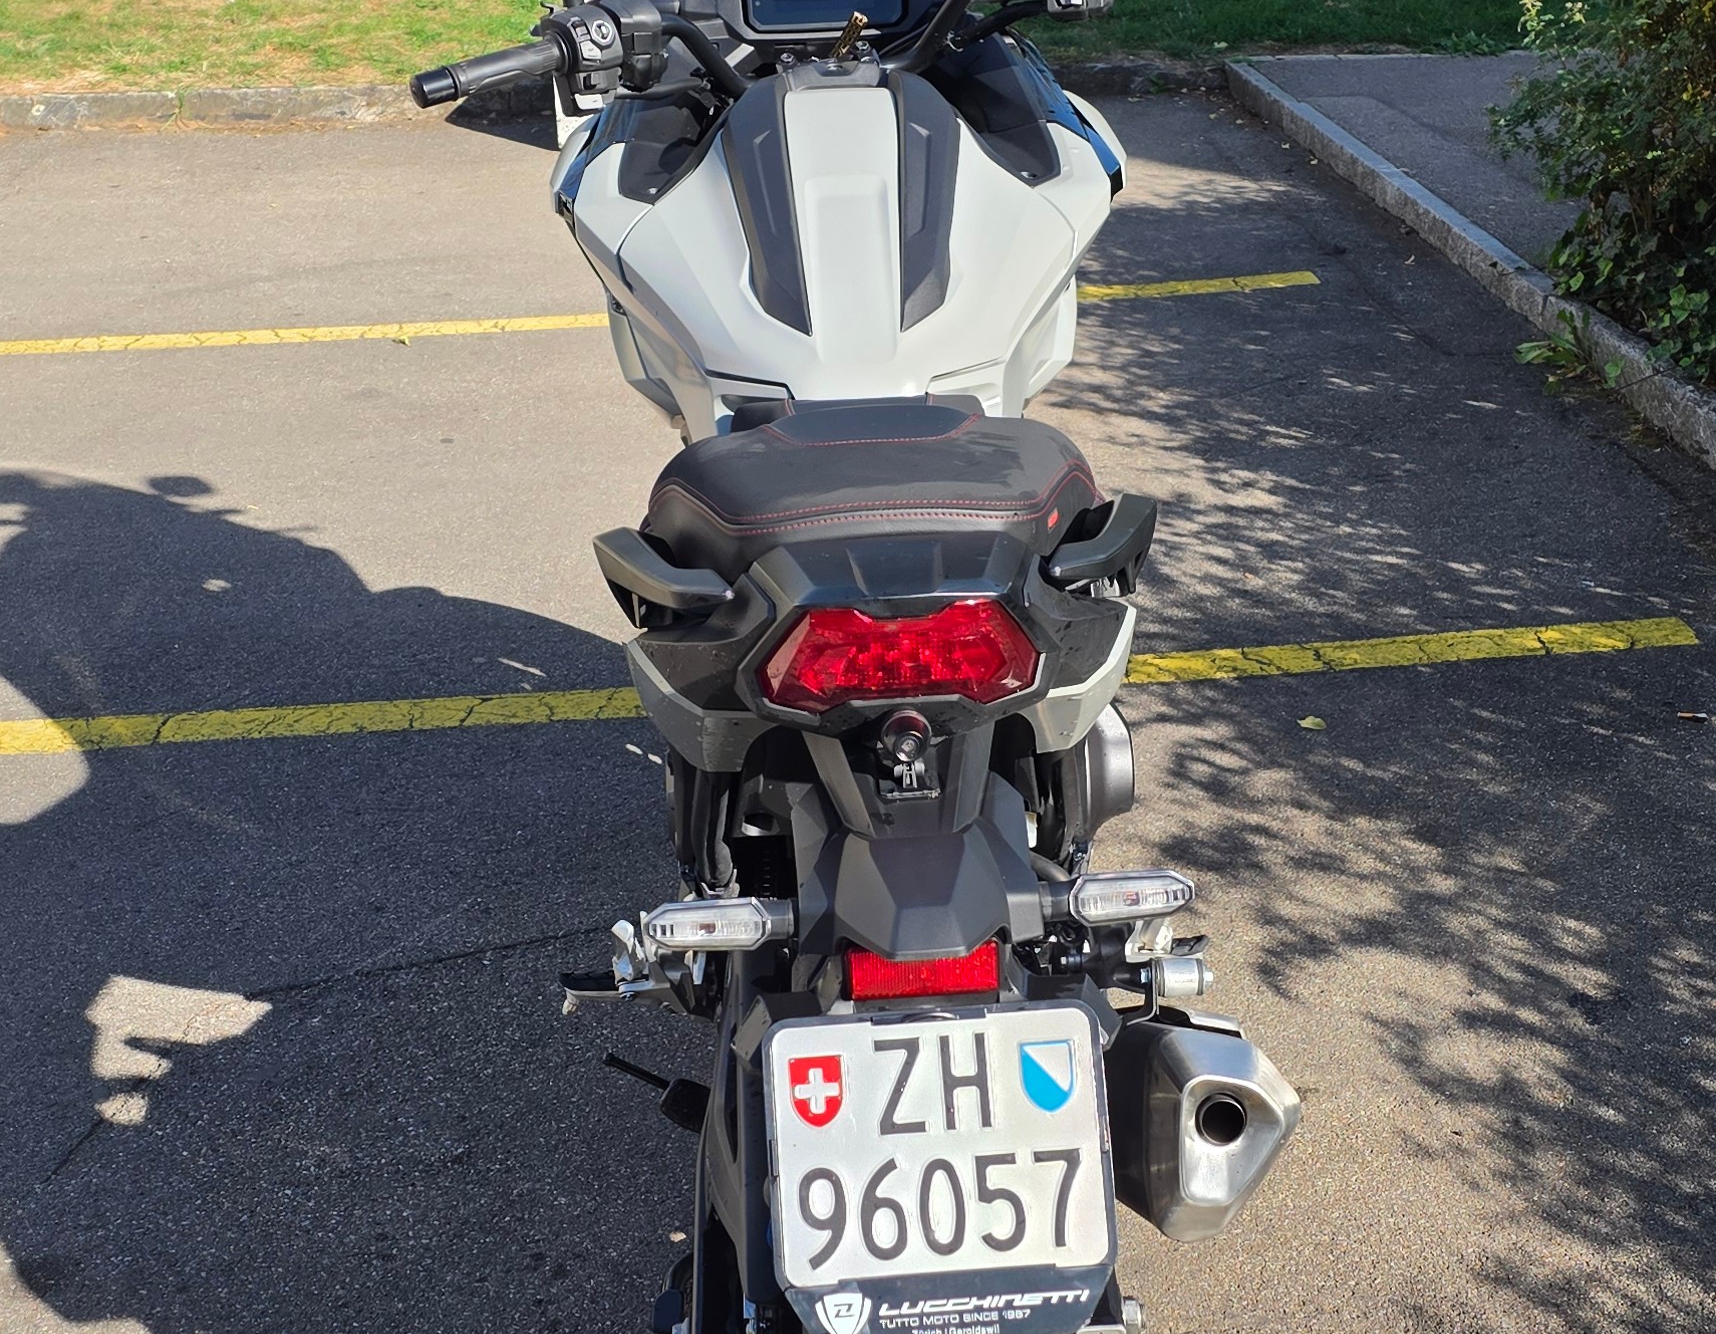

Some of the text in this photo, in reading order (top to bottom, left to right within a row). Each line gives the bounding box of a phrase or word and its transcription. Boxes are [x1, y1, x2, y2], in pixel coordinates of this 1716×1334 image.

[873, 1032, 992, 1135] ZH
[799, 1148, 1081, 1270] 96057
[879, 1289, 1090, 1316] LUCCHINETTI
[879, 1317, 919, 1329] TUTTO
[923, 1314, 959, 1325] MOTO
[963, 1311, 999, 1323] SINCE
